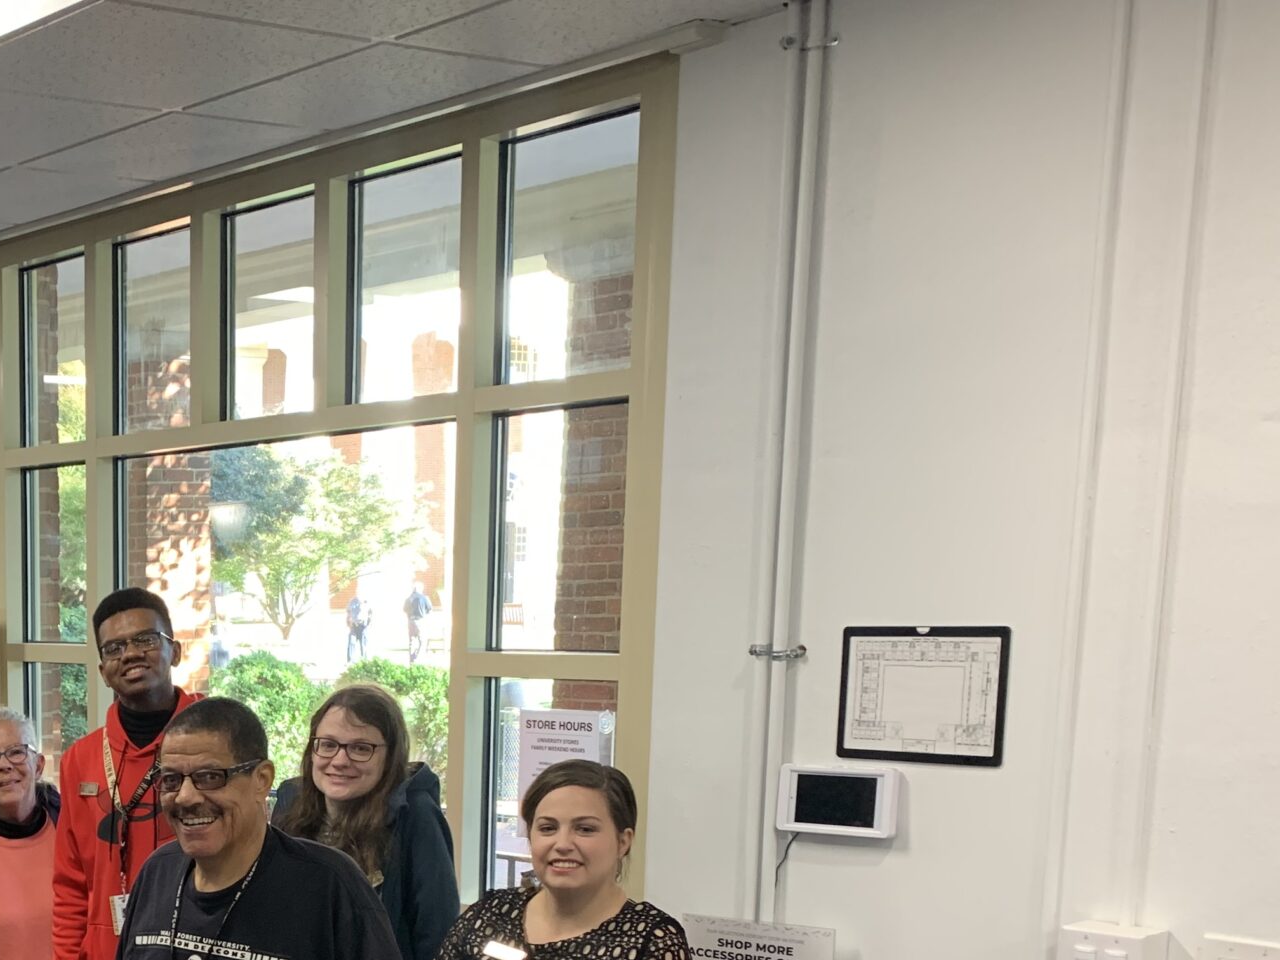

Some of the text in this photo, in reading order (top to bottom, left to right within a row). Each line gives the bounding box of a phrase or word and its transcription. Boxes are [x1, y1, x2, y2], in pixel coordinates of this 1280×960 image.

[526, 720, 593, 732] STORE HOURS
[159, 937, 189, 948] DEON
[177, 932, 201, 943] FOREST
[717, 938, 794, 957] SHOP MORE
